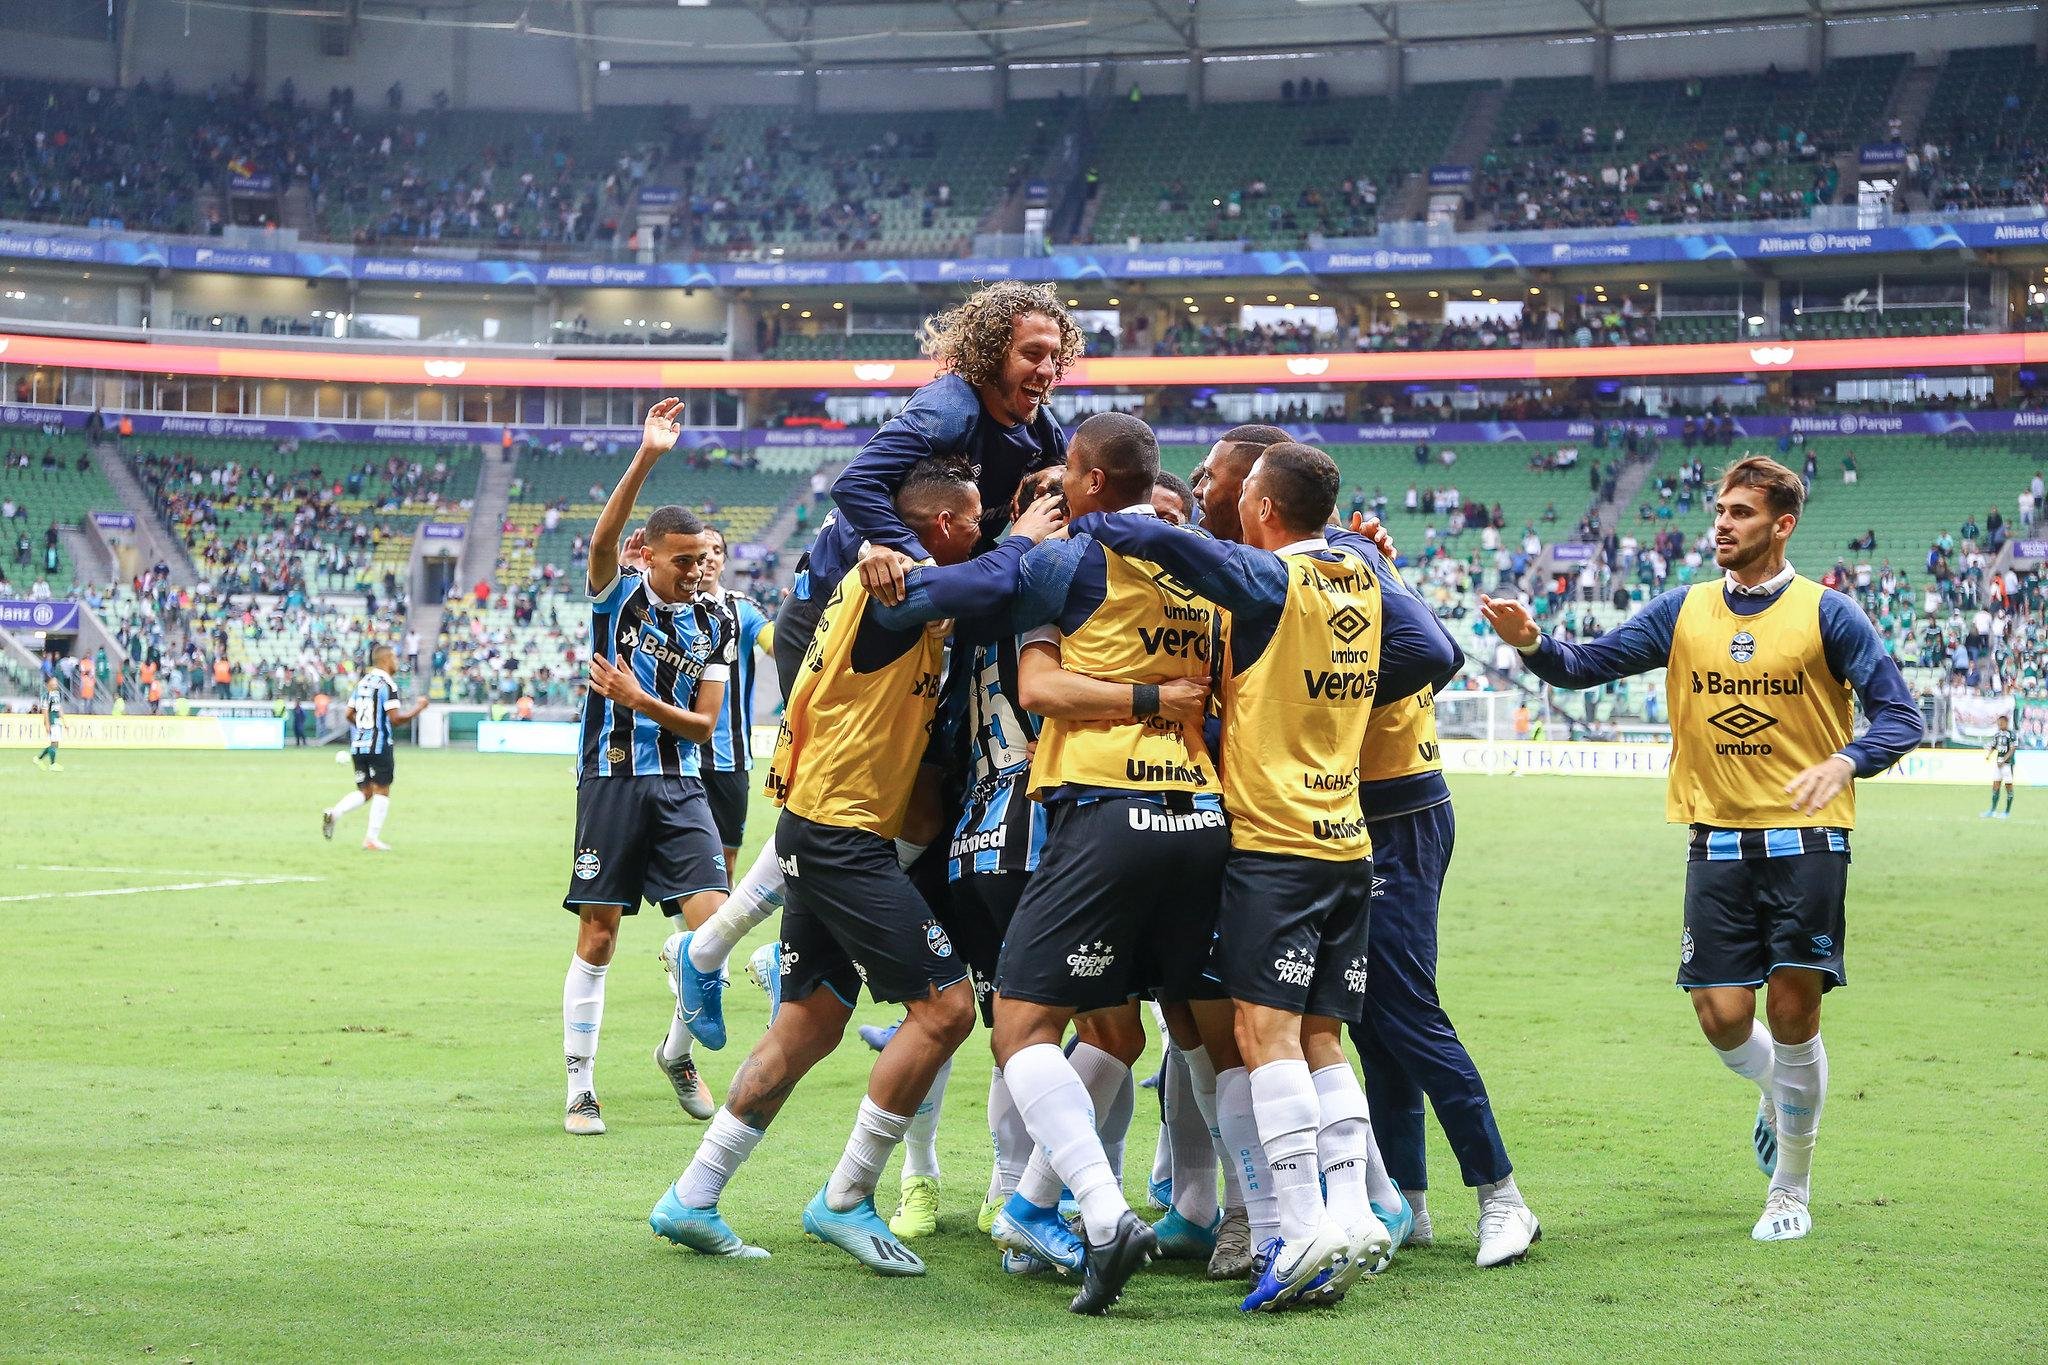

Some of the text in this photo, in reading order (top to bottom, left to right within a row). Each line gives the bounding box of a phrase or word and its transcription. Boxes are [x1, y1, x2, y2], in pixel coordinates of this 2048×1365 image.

[1994, 224, 2040, 241] Allianz
[0, 236, 93, 258] llianz Seguros
[1759, 233, 1873, 253] Allianz Parque
[1127, 258, 1166, 272] Allianz
[1328, 252, 1433, 269] Allianz Parque
[365, 261, 463, 279] Allianz Seguros
[547, 266, 590, 281] Allianz
[161, 416, 266, 435] Allianz Parque
[1791, 415, 1902, 434] Allianz Parque
[1164, 604, 1210, 623] umbro
[640, 633, 703, 679] Banris
[1331, 647, 1368, 664] umbro
[1707, 671, 1804, 696] Banrisul
[1715, 741, 1772, 756] umbro
[1463, 750, 1597, 769] CONTRATE
[1370, 889, 1385, 898] bro
[1066, 953, 1115, 967] GRÊMIO
[1070, 965, 1106, 977] MAIS
[1277, 969, 1312, 988] MAIS
[1324, 1160, 1354, 1175] mbro
